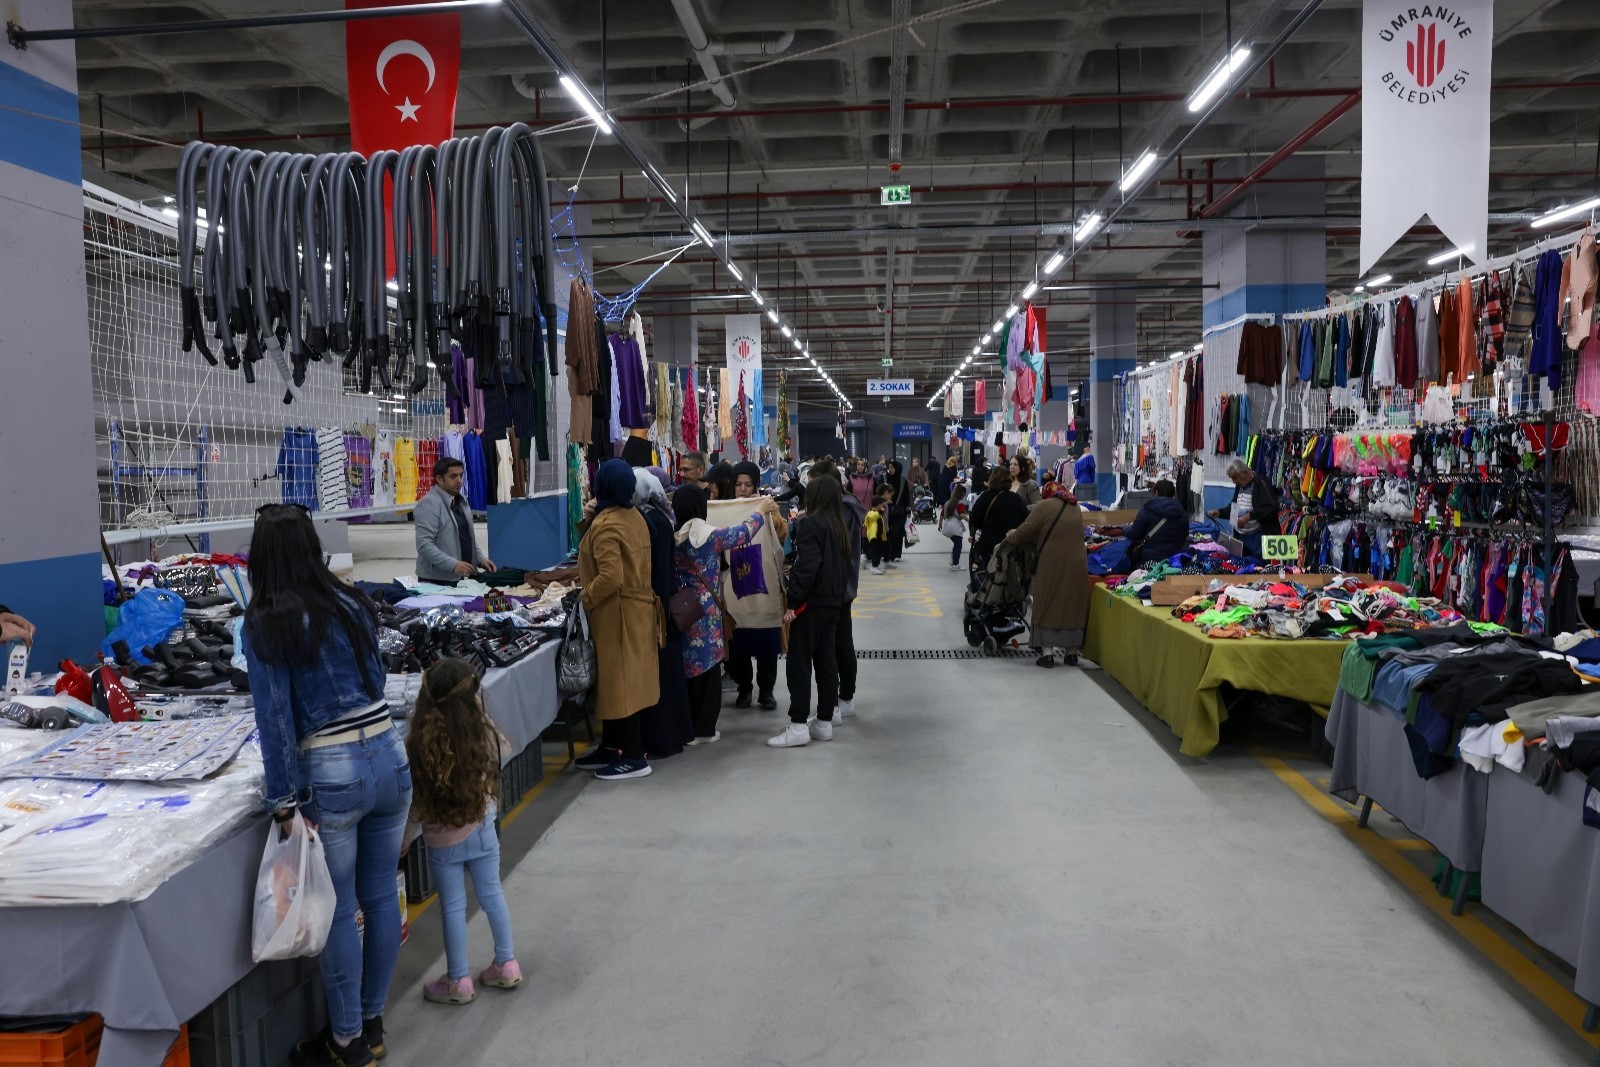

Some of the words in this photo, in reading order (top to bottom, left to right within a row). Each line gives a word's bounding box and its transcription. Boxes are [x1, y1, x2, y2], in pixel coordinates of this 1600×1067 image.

[1379, 5, 1472, 42] ÜMRANİYE
[1381, 69, 1470, 104] BELEDİYESİ
[870, 383, 878, 391] 2.
[880, 383, 911, 391] SOKAK
